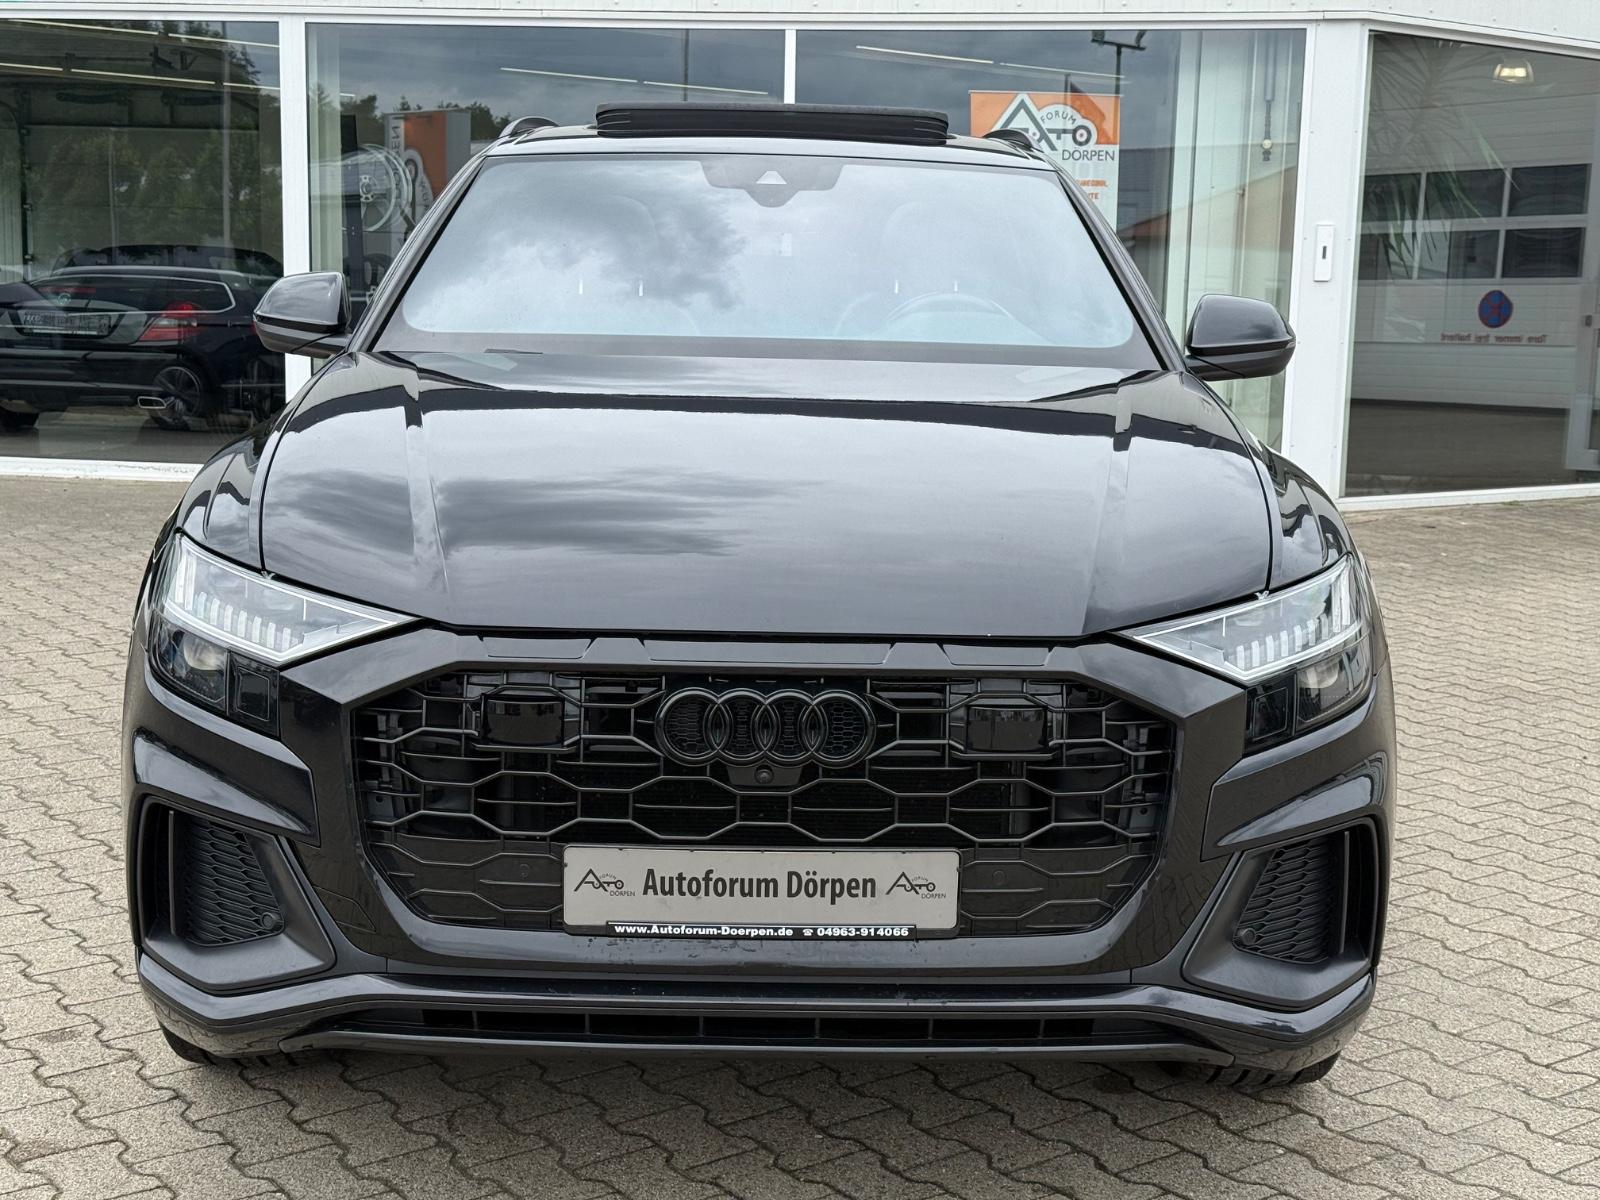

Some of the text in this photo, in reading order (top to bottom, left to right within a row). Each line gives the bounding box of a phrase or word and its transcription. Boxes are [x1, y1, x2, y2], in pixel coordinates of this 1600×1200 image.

[1040, 110, 1077, 125] FORUM
[642, 868, 876, 905] Autoforum Dörpen
[614, 924, 909, 938] www.Autoforum-Doerpen.de 04963-914066
